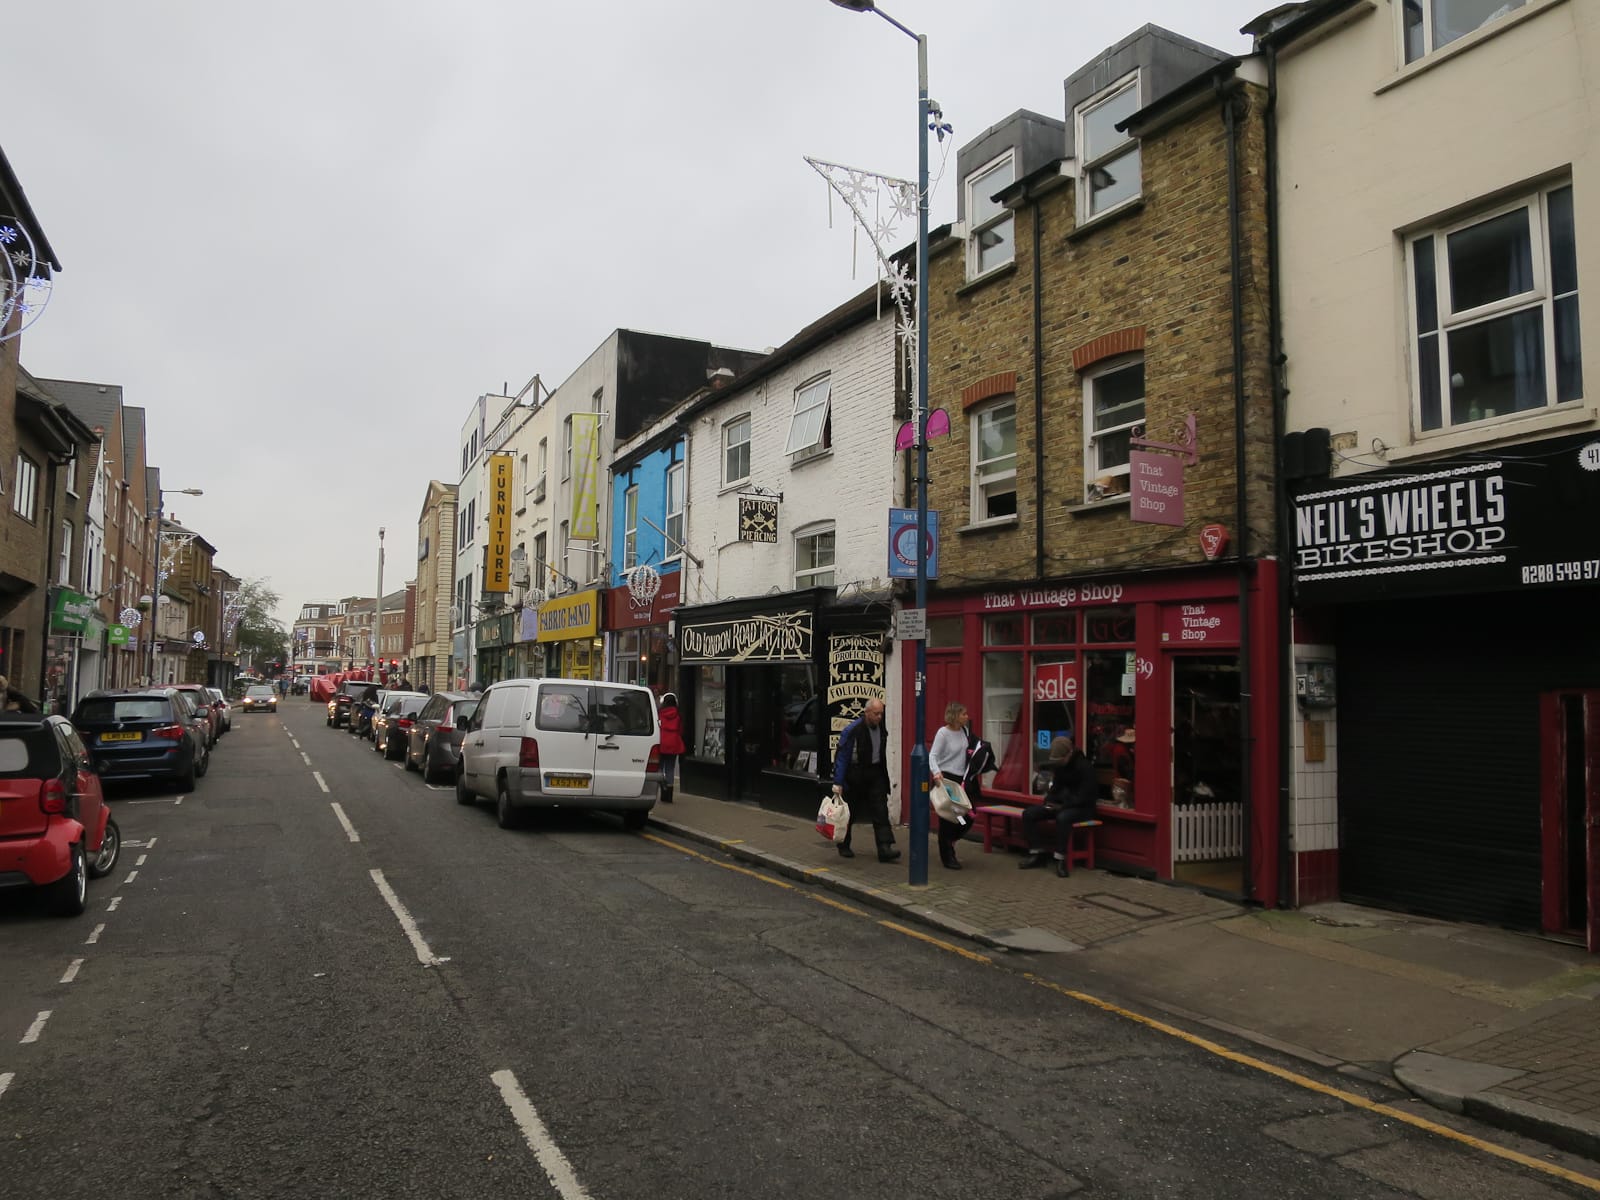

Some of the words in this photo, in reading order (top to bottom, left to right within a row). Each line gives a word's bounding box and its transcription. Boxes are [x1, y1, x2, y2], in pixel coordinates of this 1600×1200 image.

[1587, 449, 1600, 464] 41
[1139, 463, 1163, 476] That
[1139, 480, 1179, 497] Vintage
[741, 500, 776, 517] TATTOOS
[1139, 497, 1166, 513] Shop
[1297, 496, 1375, 548] NEIL'S
[1382, 475, 1505, 537] WHEELS
[494, 464, 507, 584] FURNITURE
[903, 512, 913, 521] let
[741, 530, 776, 542] PIERCING
[1298, 526, 1505, 570] BIKESHOP
[1522, 564, 1554, 584] 0208
[1556, 561, 1582, 581] 549
[983, 592, 1015, 609] That
[1020, 588, 1076, 607] Vintage
[1081, 583, 1123, 603] Shop
[568, 603, 590, 627] LAND
[1182, 605, 1205, 615] That
[1182, 616, 1221, 629] Vintage
[684, 628, 702, 653] OLD
[703, 628, 732, 658] LONDON
[732, 622, 757, 655] ROAD
[756, 619, 803, 651] TATTOOS
[834, 638, 881, 648] FAMOUSLY
[1181, 629, 1207, 641] Shop
[835, 651, 879, 663] PROFICIENT
[848, 663, 865, 672] IN
[1136, 657, 1154, 680] 39
[840, 672, 871, 682] THE
[1037, 665, 1077, 700] sale
[830, 684, 884, 700] FOLLOWING
